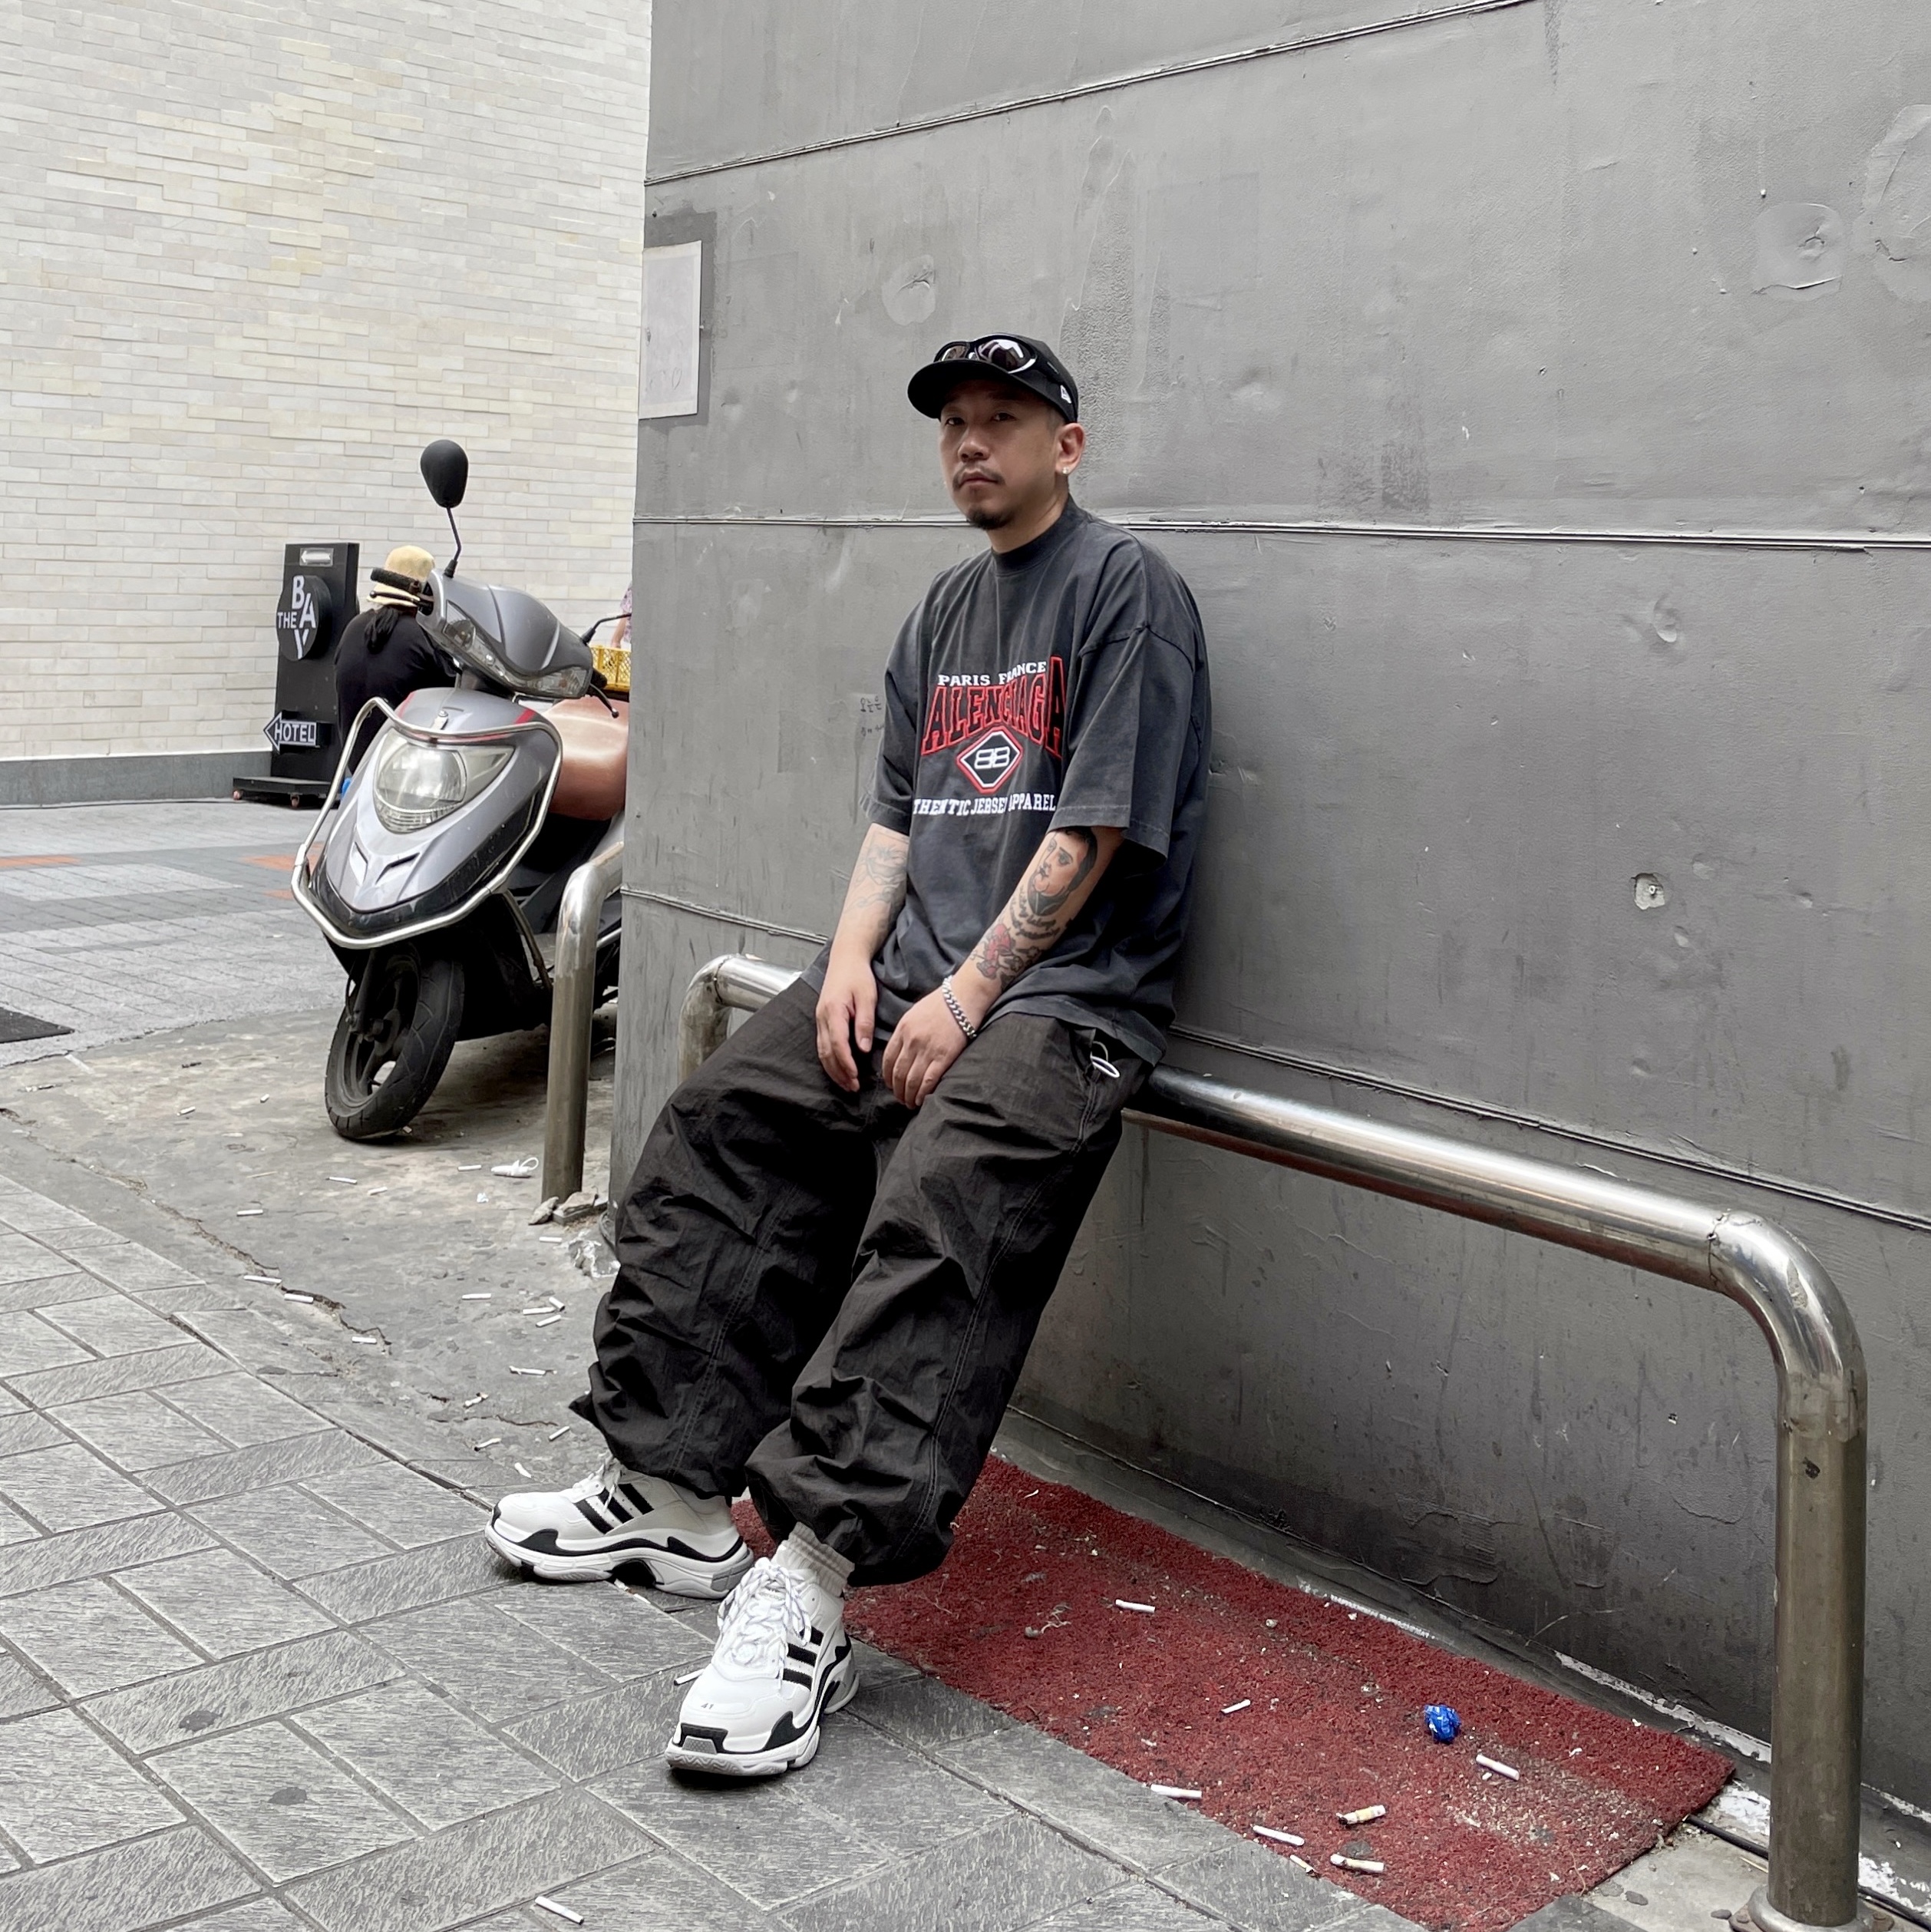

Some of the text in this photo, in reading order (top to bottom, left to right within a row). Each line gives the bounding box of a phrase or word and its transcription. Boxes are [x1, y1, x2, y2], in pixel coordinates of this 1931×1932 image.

[277, 575, 316, 660] THE BAY
[937, 674, 991, 686] PARIS
[274, 723, 315, 742] HOTEL
[970, 797, 1008, 815] JERSE
